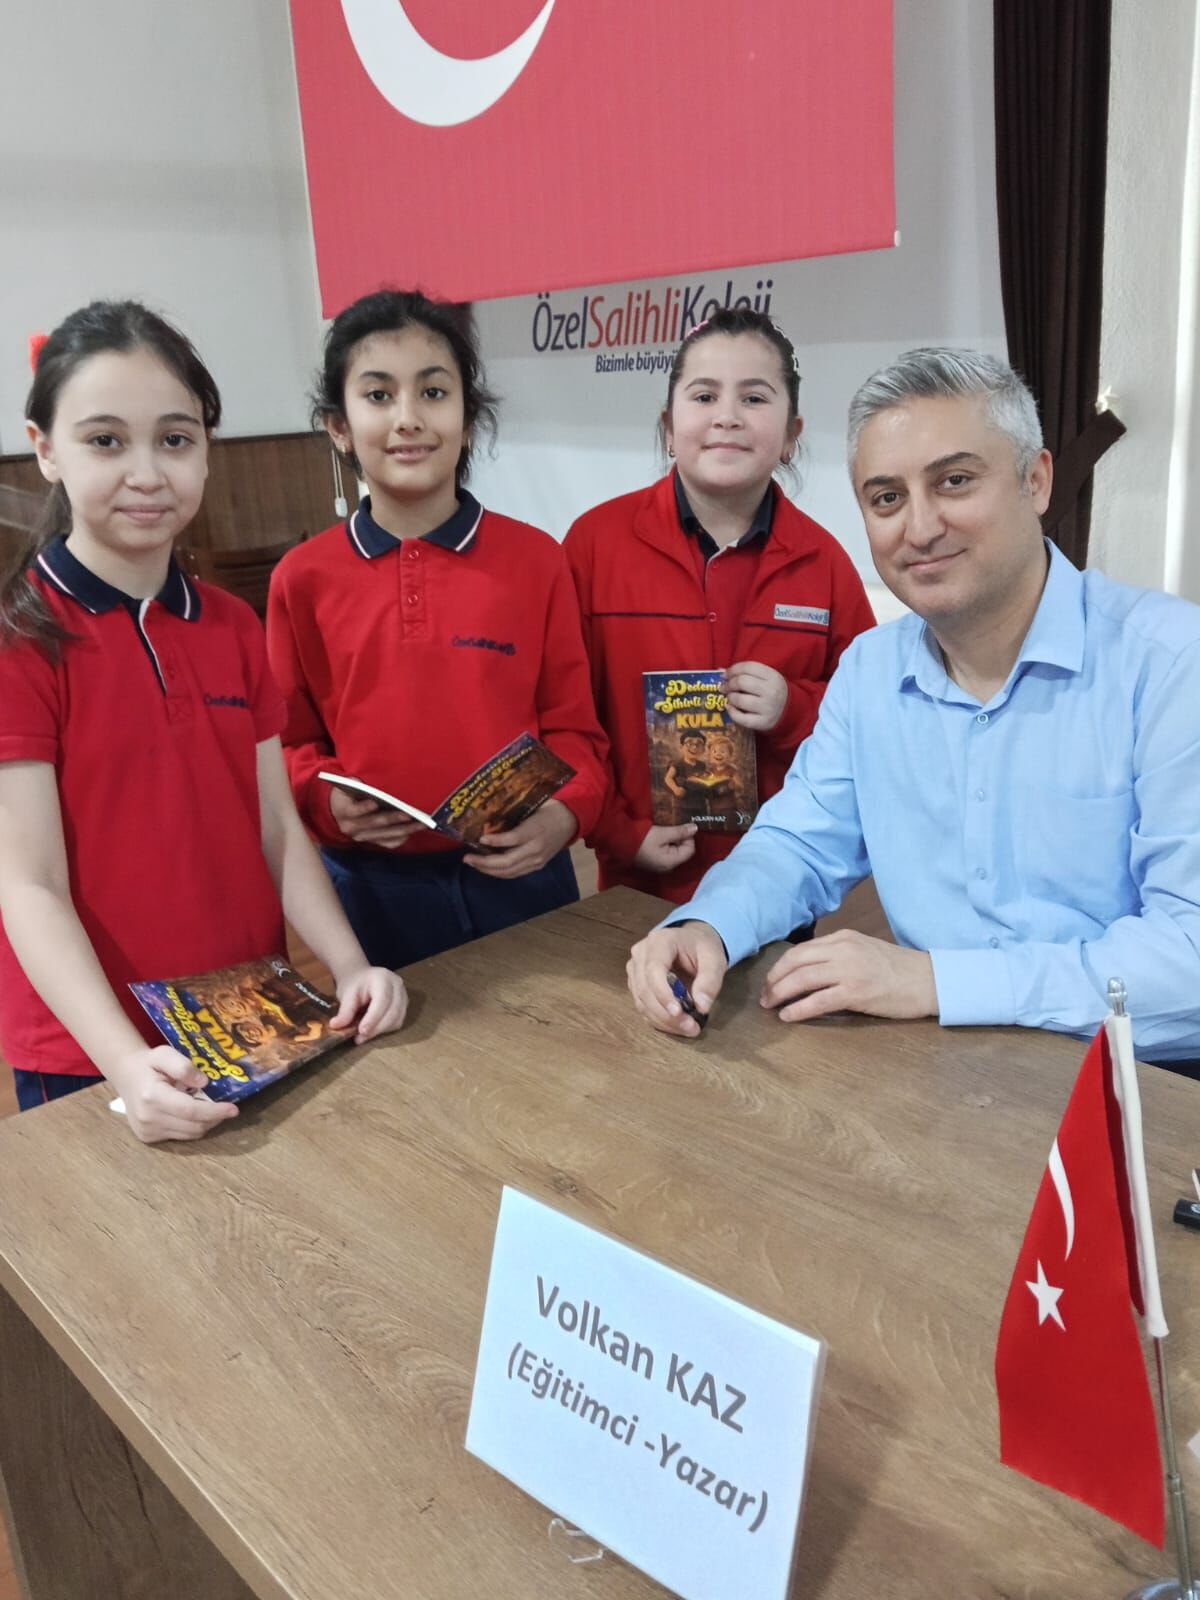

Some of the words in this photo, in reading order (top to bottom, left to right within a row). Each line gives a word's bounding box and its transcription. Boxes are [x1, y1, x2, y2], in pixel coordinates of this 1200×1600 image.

[595, 352, 634, 373] Bizimle
[665, 679, 722, 697] Dedemi
[676, 712, 724, 729] KULA
[196, 1007, 249, 1060] KULA
[535, 1275, 655, 1380] Volkan
[666, 1352, 749, 1433] KAZ
[507, 1341, 640, 1447] (Eğitimci
[644, 1432, 769, 1533] -Yazar)
